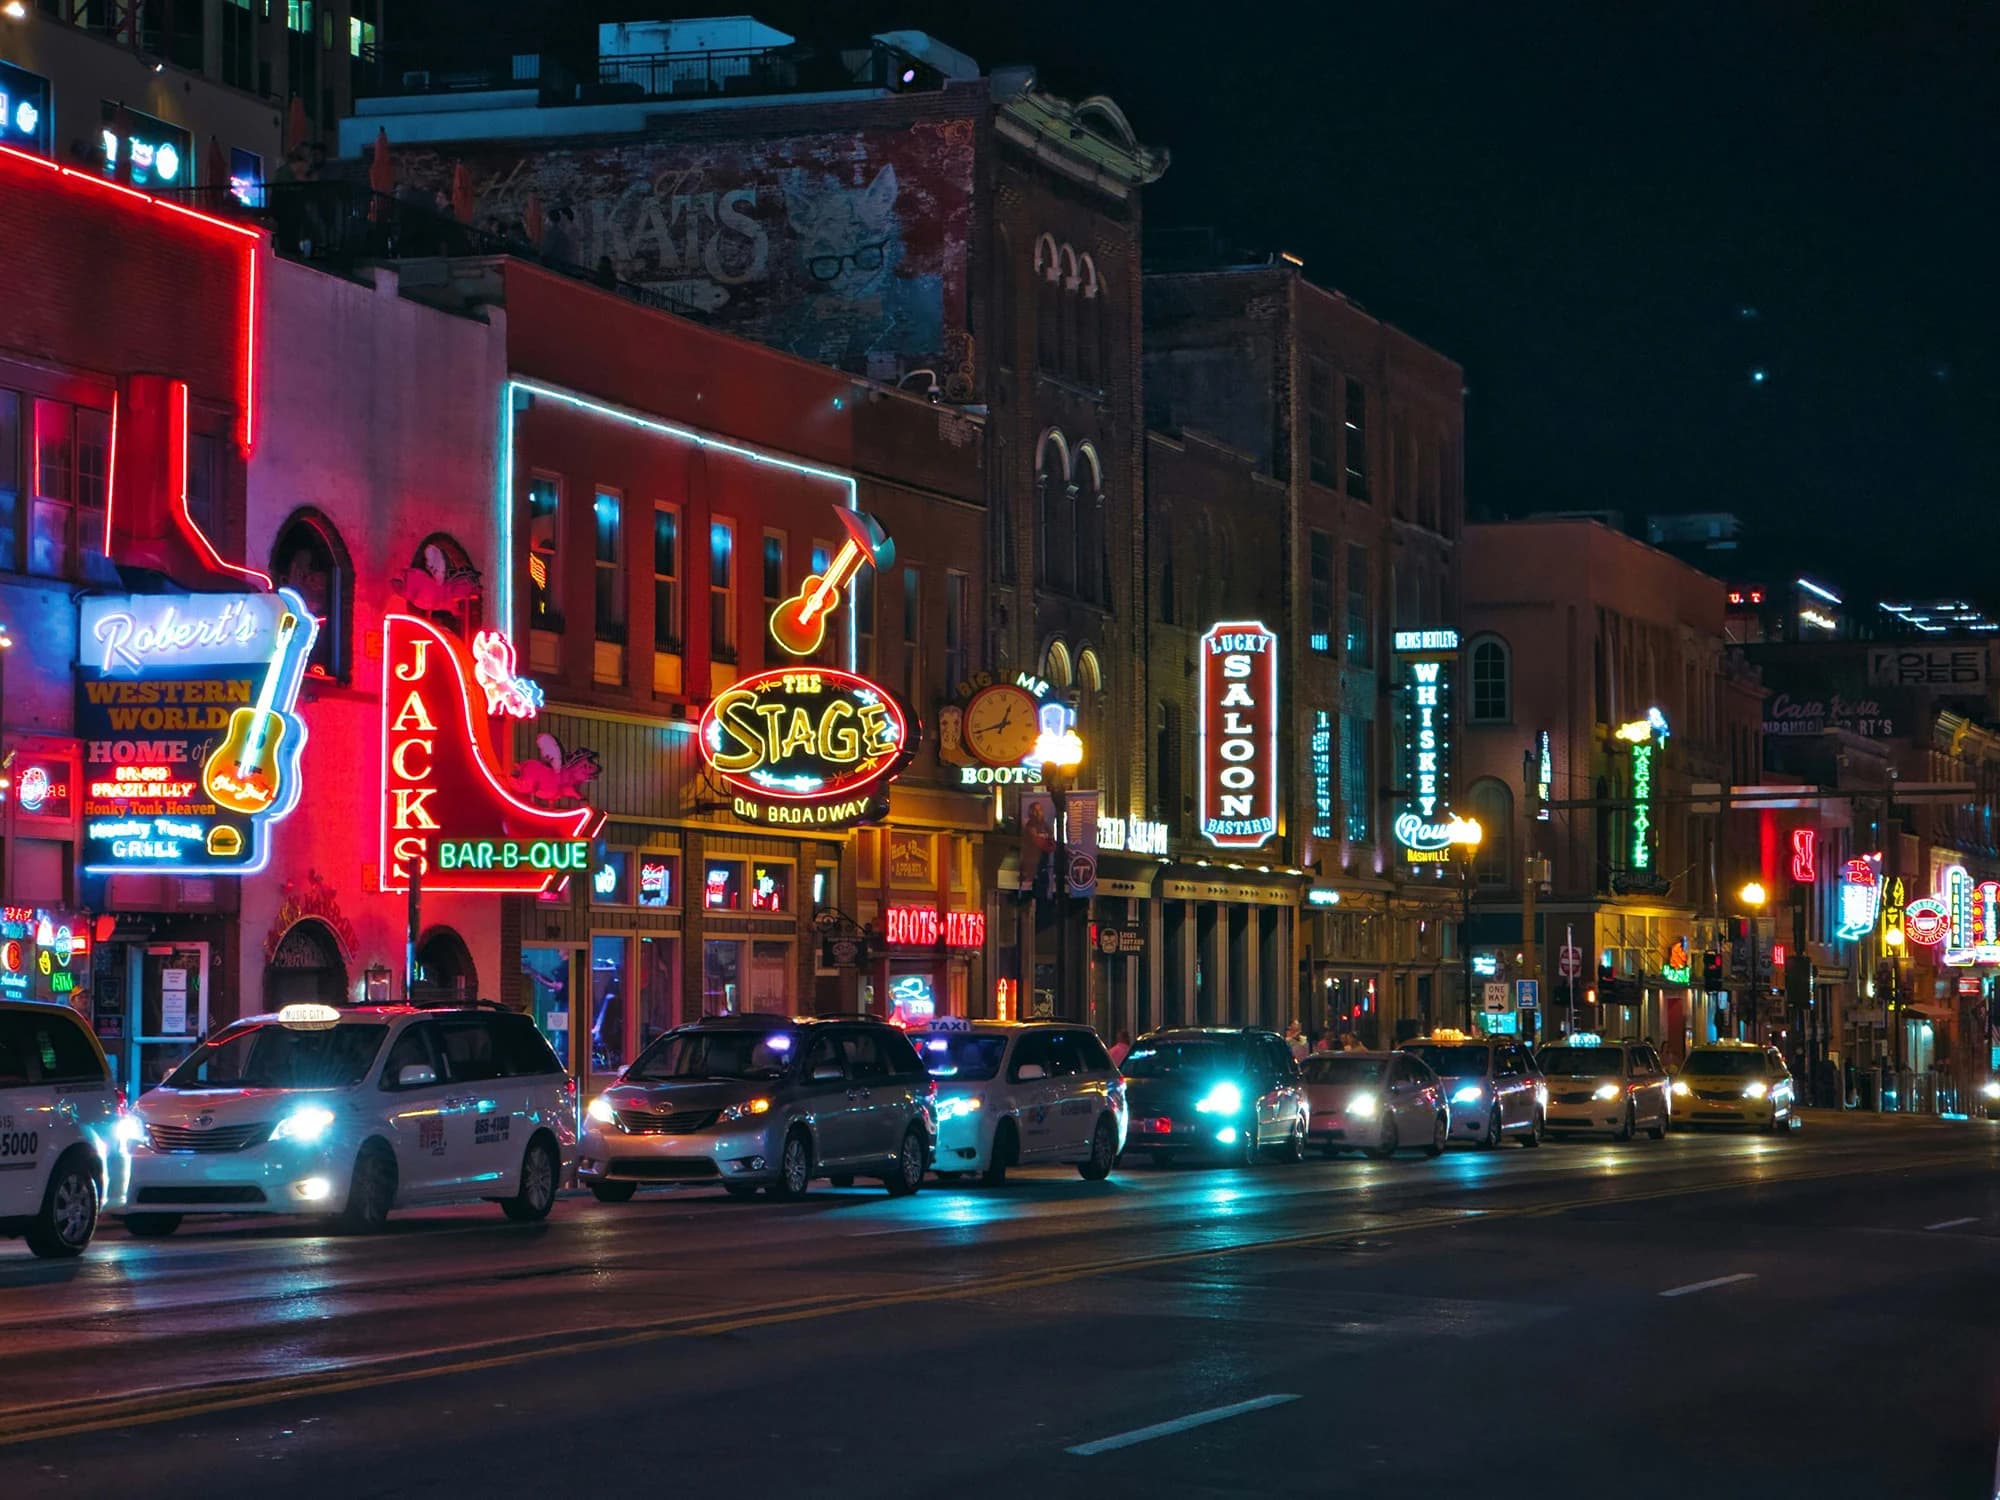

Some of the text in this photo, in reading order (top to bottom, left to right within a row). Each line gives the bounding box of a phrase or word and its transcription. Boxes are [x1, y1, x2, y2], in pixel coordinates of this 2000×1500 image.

[95, 600, 257, 675] Robert's
[1208, 634, 1270, 654] LUCKY
[1901, 652, 1979, 668] OLE
[783, 674, 821, 693] THE
[1901, 668, 1980, 684] RED
[85, 680, 252, 705] WESTERN
[1771, 694, 1825, 718] Casa
[109, 707, 230, 731] WORLD
[712, 690, 898, 773] STAGE
[1220, 654, 1255, 817] SALOON
[1414, 663, 1440, 816] WHISKEY
[89, 738, 213, 769] HOME of
[391, 640, 440, 879] JACKS
[960, 767, 1042, 784] BOOTS
[85, 801, 216, 818] Honky Tonk Heaven
[734, 797, 869, 823] ON BROADWAY
[1633, 745, 1652, 868] MARGARTAVILLE
[1206, 817, 1272, 836] BASTARD
[113, 841, 182, 857] GRILL
[440, 842, 588, 868] BAR-B-QUE
[1407, 848, 1450, 862] NASHVILLE
[1847, 860, 1870, 871] Tin
[1847, 872, 1875, 886] Roof
[887, 908, 985, 947] BOOTS HATS
[52, 973, 73, 992] ATM
[1489, 985, 1505, 993] ONE
[929, 1020, 969, 1031] TAXI
